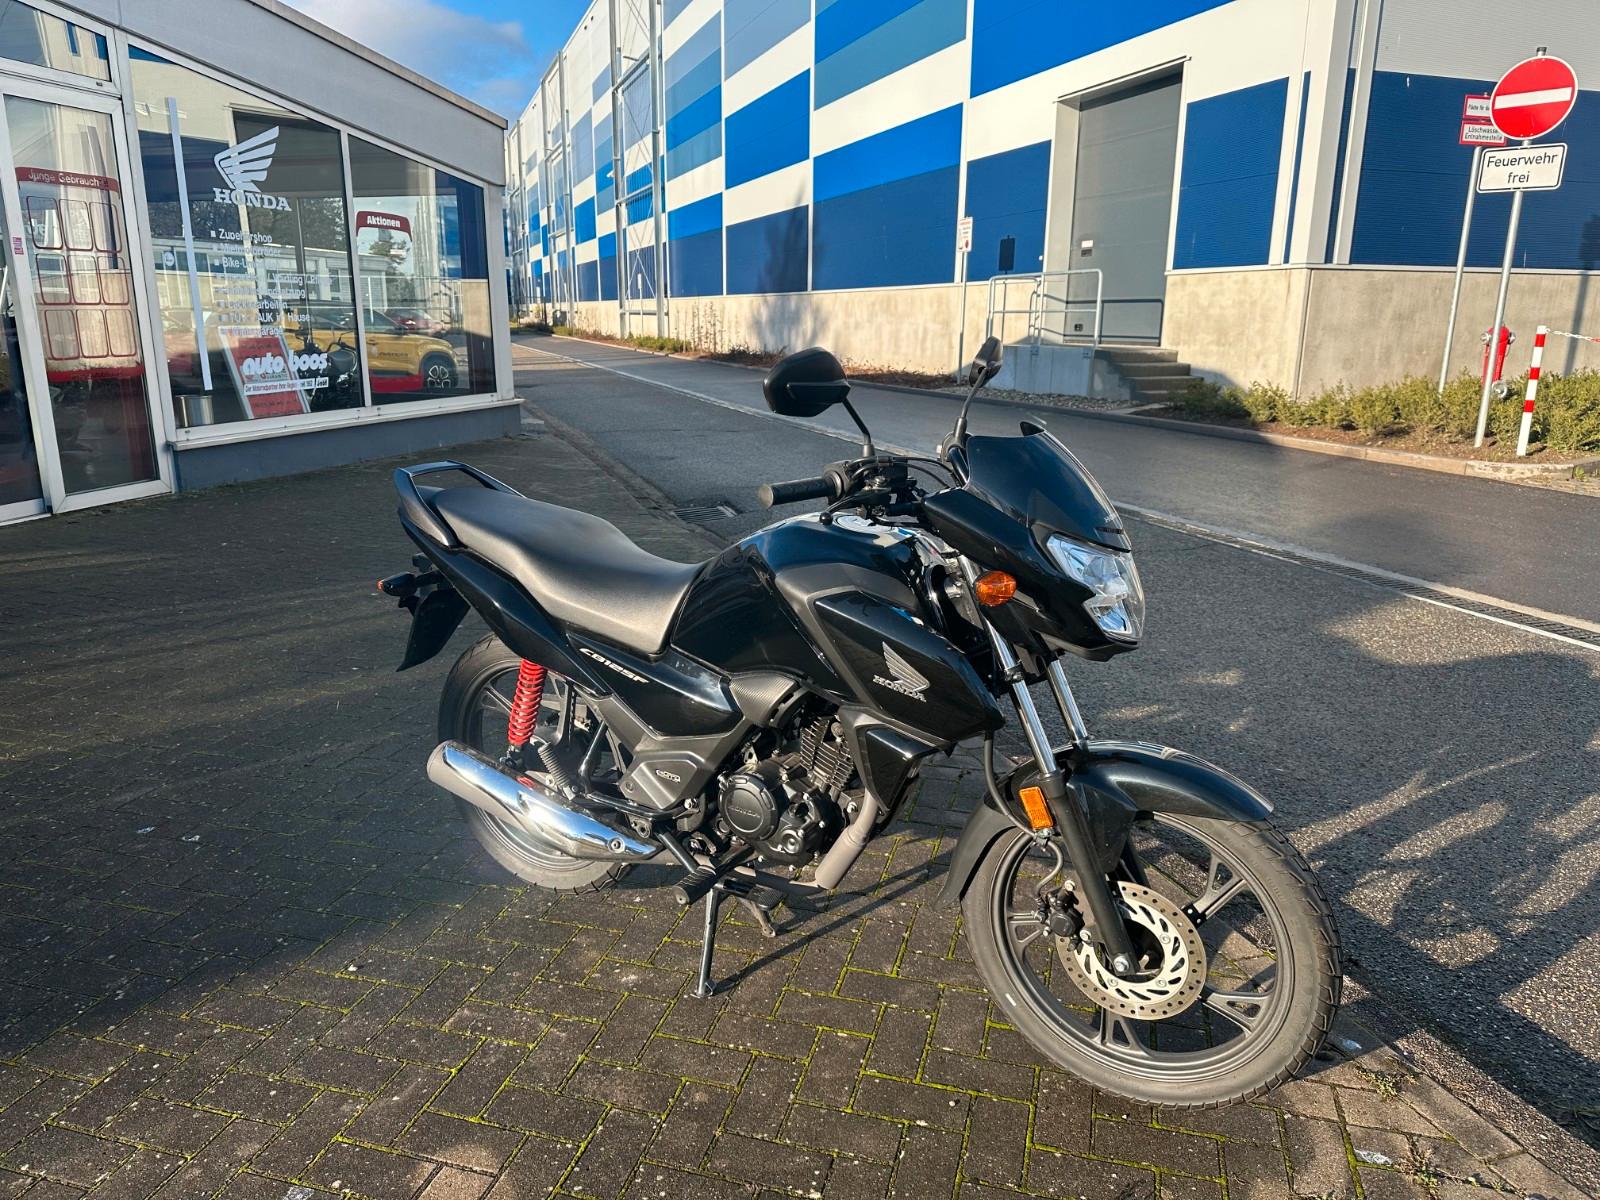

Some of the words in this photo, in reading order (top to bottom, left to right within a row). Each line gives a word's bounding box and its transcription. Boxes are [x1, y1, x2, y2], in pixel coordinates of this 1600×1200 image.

[1468, 126, 1499, 134] Löschwasse
[1486, 152, 1558, 168] Feuerwehr
[1507, 171, 1530, 184] frei
[212, 187, 293, 212] HONDA
[366, 215, 401, 228] Aktionen
[242, 352, 284, 376] auto
[288, 349, 328, 373] boos
[872, 674, 927, 703] HONDA
